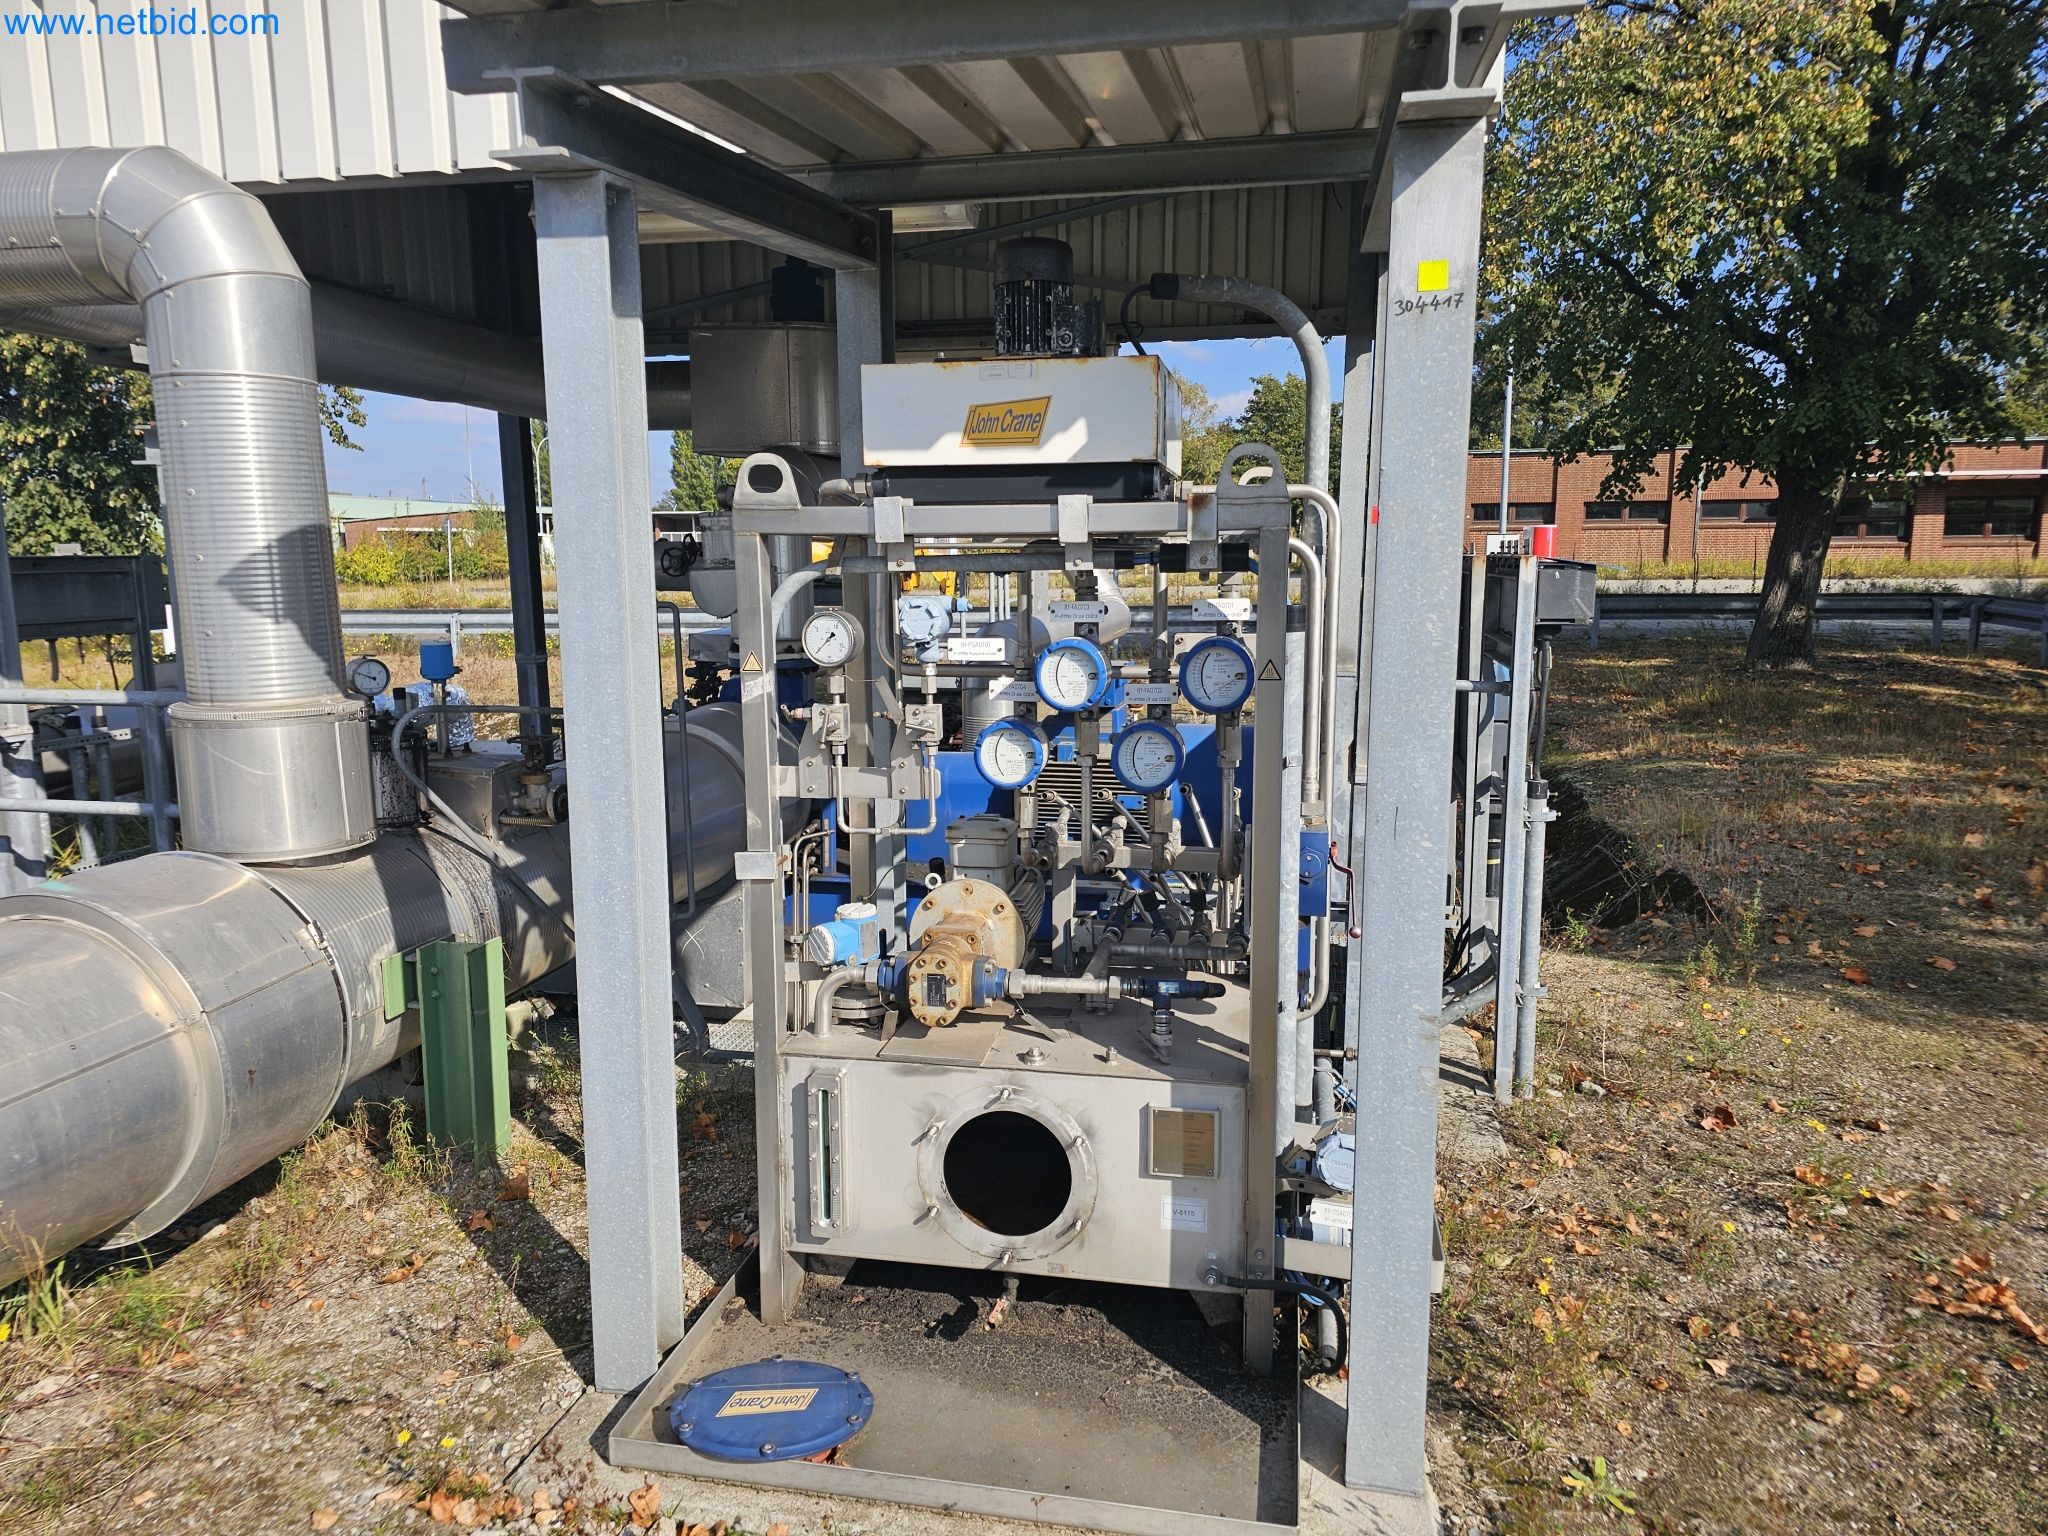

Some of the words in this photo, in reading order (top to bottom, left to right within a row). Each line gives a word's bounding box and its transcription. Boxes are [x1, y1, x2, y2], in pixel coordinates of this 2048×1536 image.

[1394, 292, 1465, 316] 304417
[971, 411, 1000, 434] John
[1000, 408, 1042, 433] Crane
[729, 1396, 774, 1409] Crane
[774, 1394, 806, 1405] John
